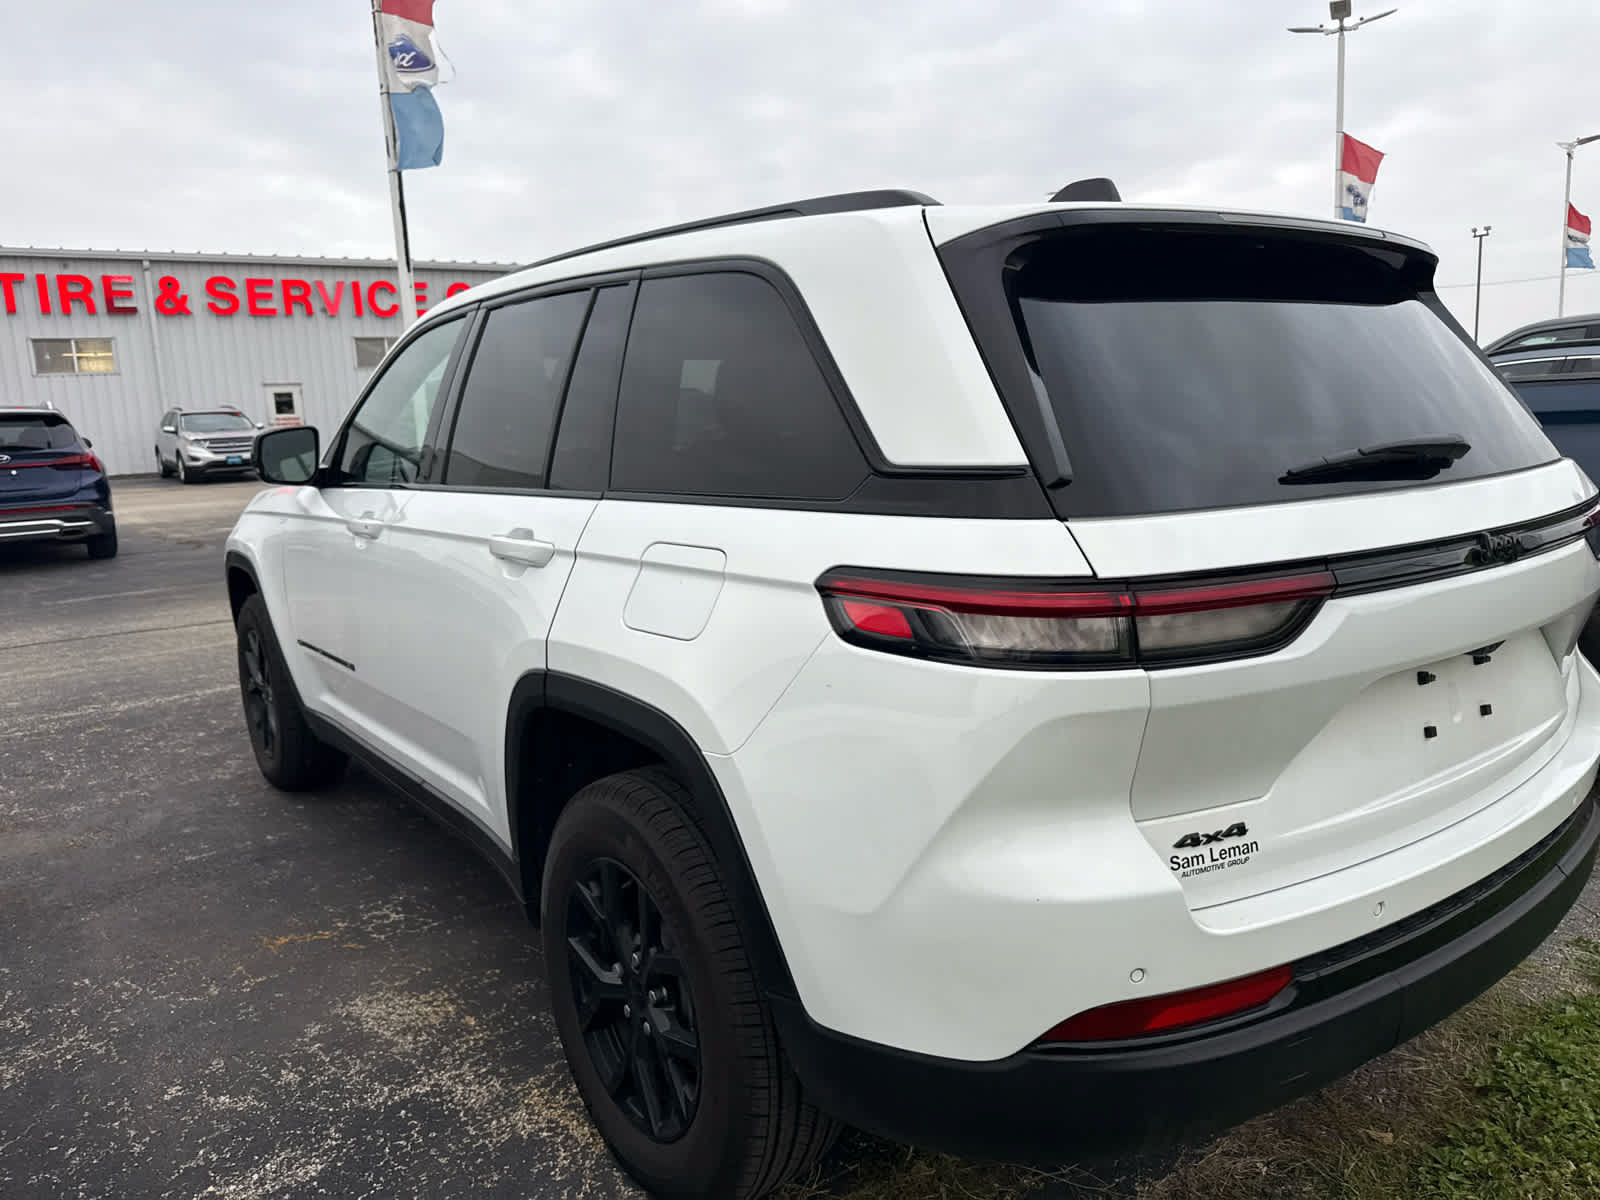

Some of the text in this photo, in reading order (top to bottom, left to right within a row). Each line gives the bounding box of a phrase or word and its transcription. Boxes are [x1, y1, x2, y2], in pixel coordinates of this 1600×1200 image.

[0, 273, 138, 315] TIRE
[154, 275, 192, 315] &
[1173, 822, 1248, 848] 4x4
[1170, 841, 1259, 871] Sam Leman
[1181, 856, 1250, 878] AUTOMOTIVE GROUP
